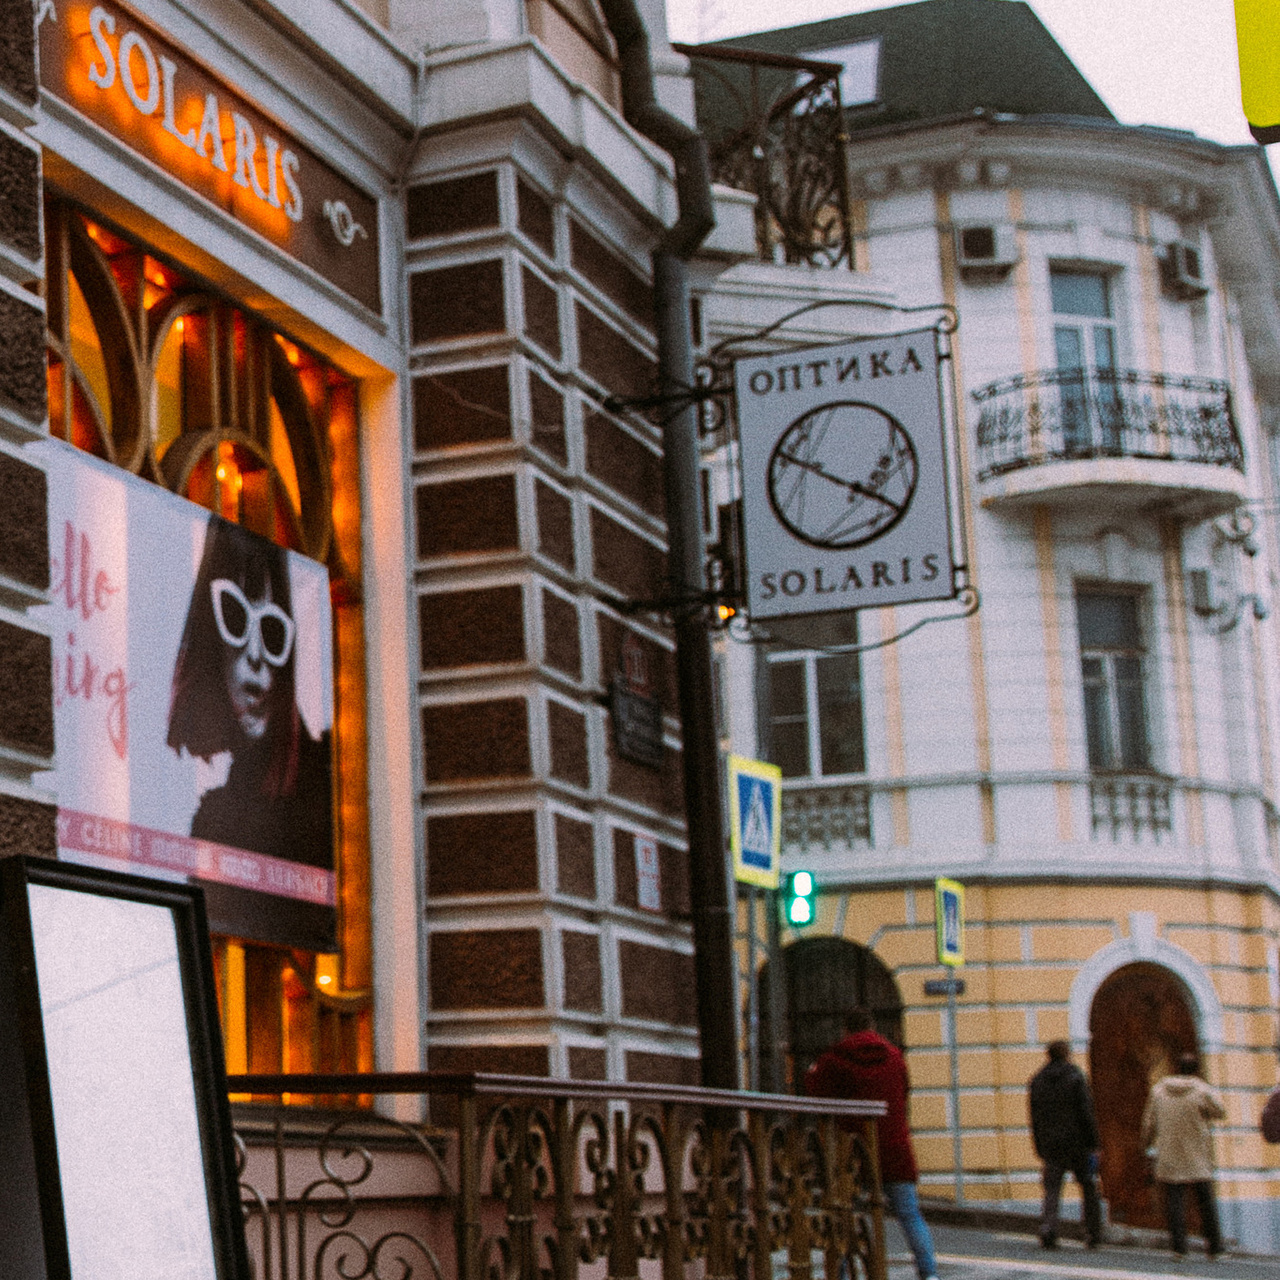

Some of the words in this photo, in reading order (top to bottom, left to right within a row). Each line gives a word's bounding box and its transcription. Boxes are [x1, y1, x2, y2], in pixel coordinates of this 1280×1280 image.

[88, 5, 304, 223] SOLARIS
[748, 346, 924, 397] ОПТИКА
[760, 553, 940, 600] SOLARIS
